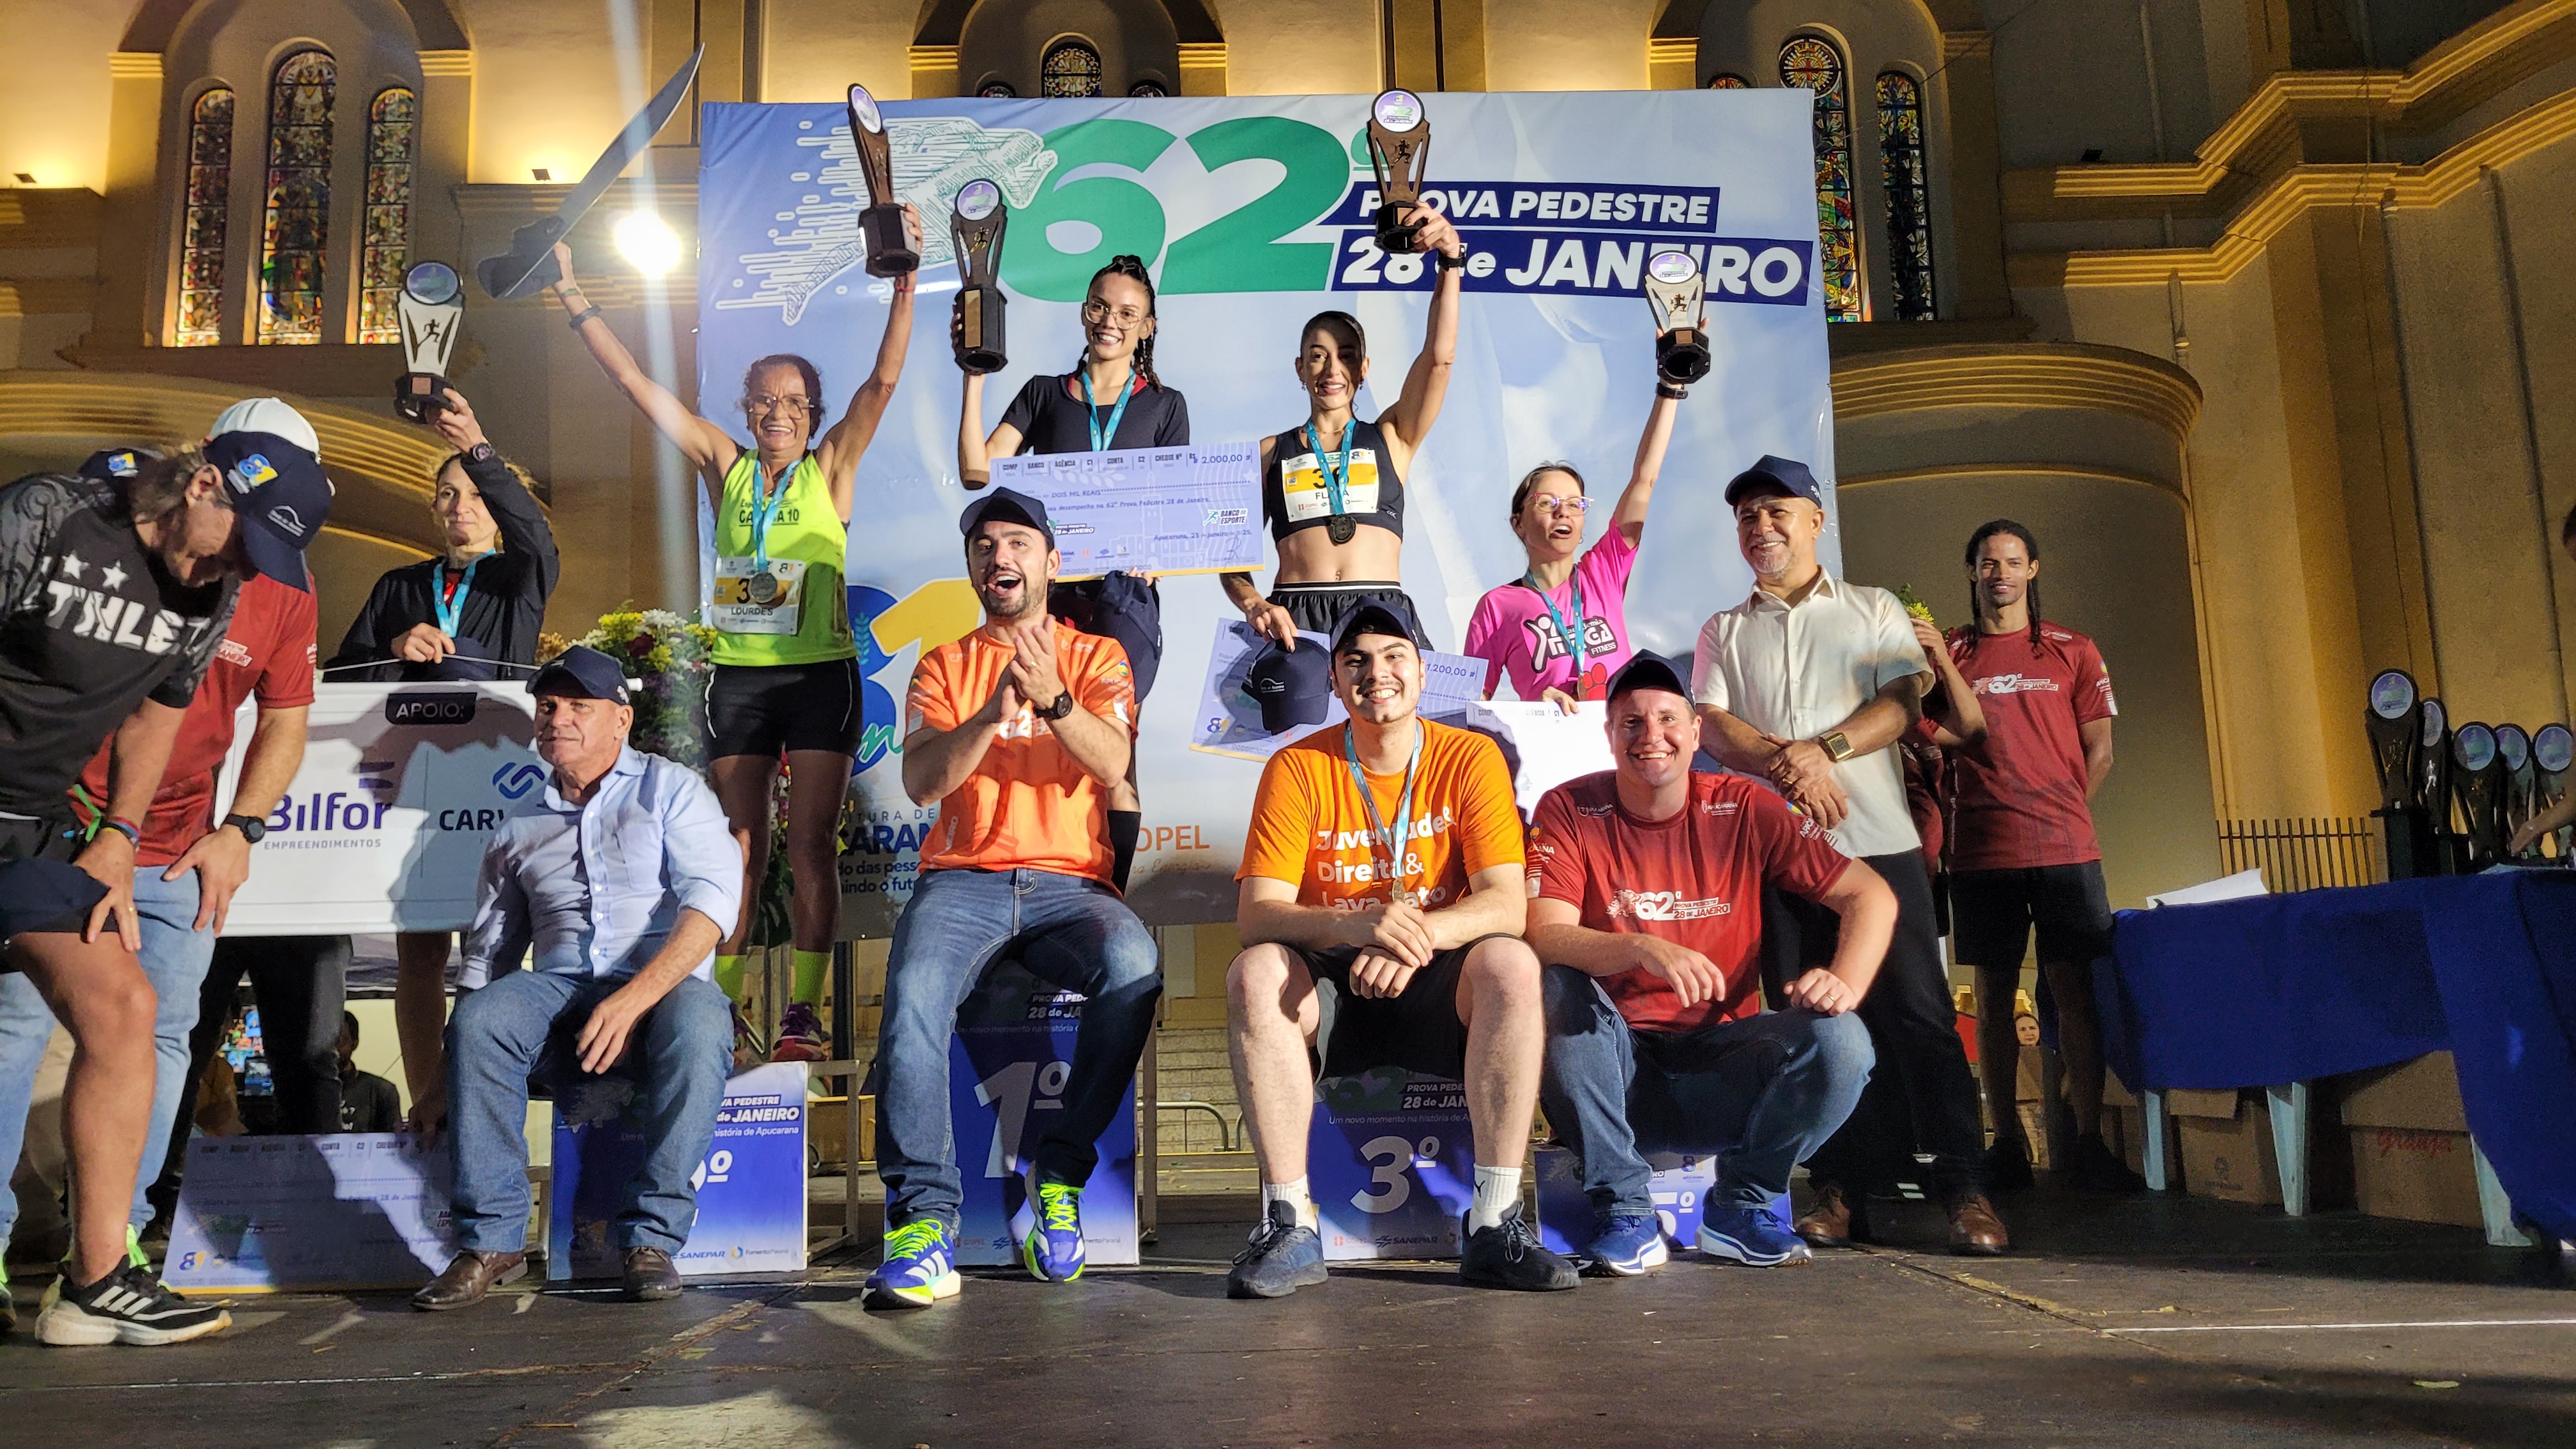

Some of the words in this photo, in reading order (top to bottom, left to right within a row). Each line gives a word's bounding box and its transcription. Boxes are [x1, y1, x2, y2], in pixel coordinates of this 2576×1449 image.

[1360, 190, 1500, 218] POVA
[1510, 191, 1710, 224] PEDESTRE
[1342, 236, 1424, 284] 28
[1506, 238, 1802, 297] JANIRO
[1201, 454, 1243, 464] 2.000,00
[788, 509, 799, 521] 10
[731, 607, 773, 616] LOURDES
[1591, 642, 1616, 655] FITNESS
[1427, 664, 1466, 677] 1.200,00
[395, 703, 465, 718] APOIO:
[1207, 717, 1229, 733] 81
[265, 793, 391, 831] Bilfor
[914, 808, 935, 819] DE
[440, 809, 503, 831] CAR
[264, 839, 381, 850] EMPREENDIMENTOS
[1135, 825, 1210, 852] OPEL
[856, 860, 881, 875] das
[885, 862, 917, 877] pess
[880, 882, 888, 891] o
[892, 877, 914, 891] fut
[1389, 886, 1446, 908] ato
[1694, 905, 1728, 917] JANEIRO
[1032, 994, 1064, 1002] PROVA
[1028, 1008, 1047, 1018] 28
[1048, 1008, 1062, 1017] de
[1407, 1084, 1438, 1092] PROVA
[733, 1096, 780, 1106] PEDESTRE
[1403, 1096, 1422, 1109] 28
[1423, 1098, 1436, 1107] de
[1439, 1095, 1467, 1108] JAN
[717, 1112, 731, 1122] de
[732, 1107, 799, 1123] JANEIRO
[974, 1061, 1071, 1178] 1º
[1329, 1116, 1344, 1124] Um
[744, 1128, 754, 1136] de
[755, 1127, 799, 1137] Apucarana
[1350, 1136, 1440, 1214] 3º
[1393, 1236, 1438, 1245] SANEPAR
[180, 1252, 205, 1271] 81
[679, 1251, 725, 1259] SANEPAR
